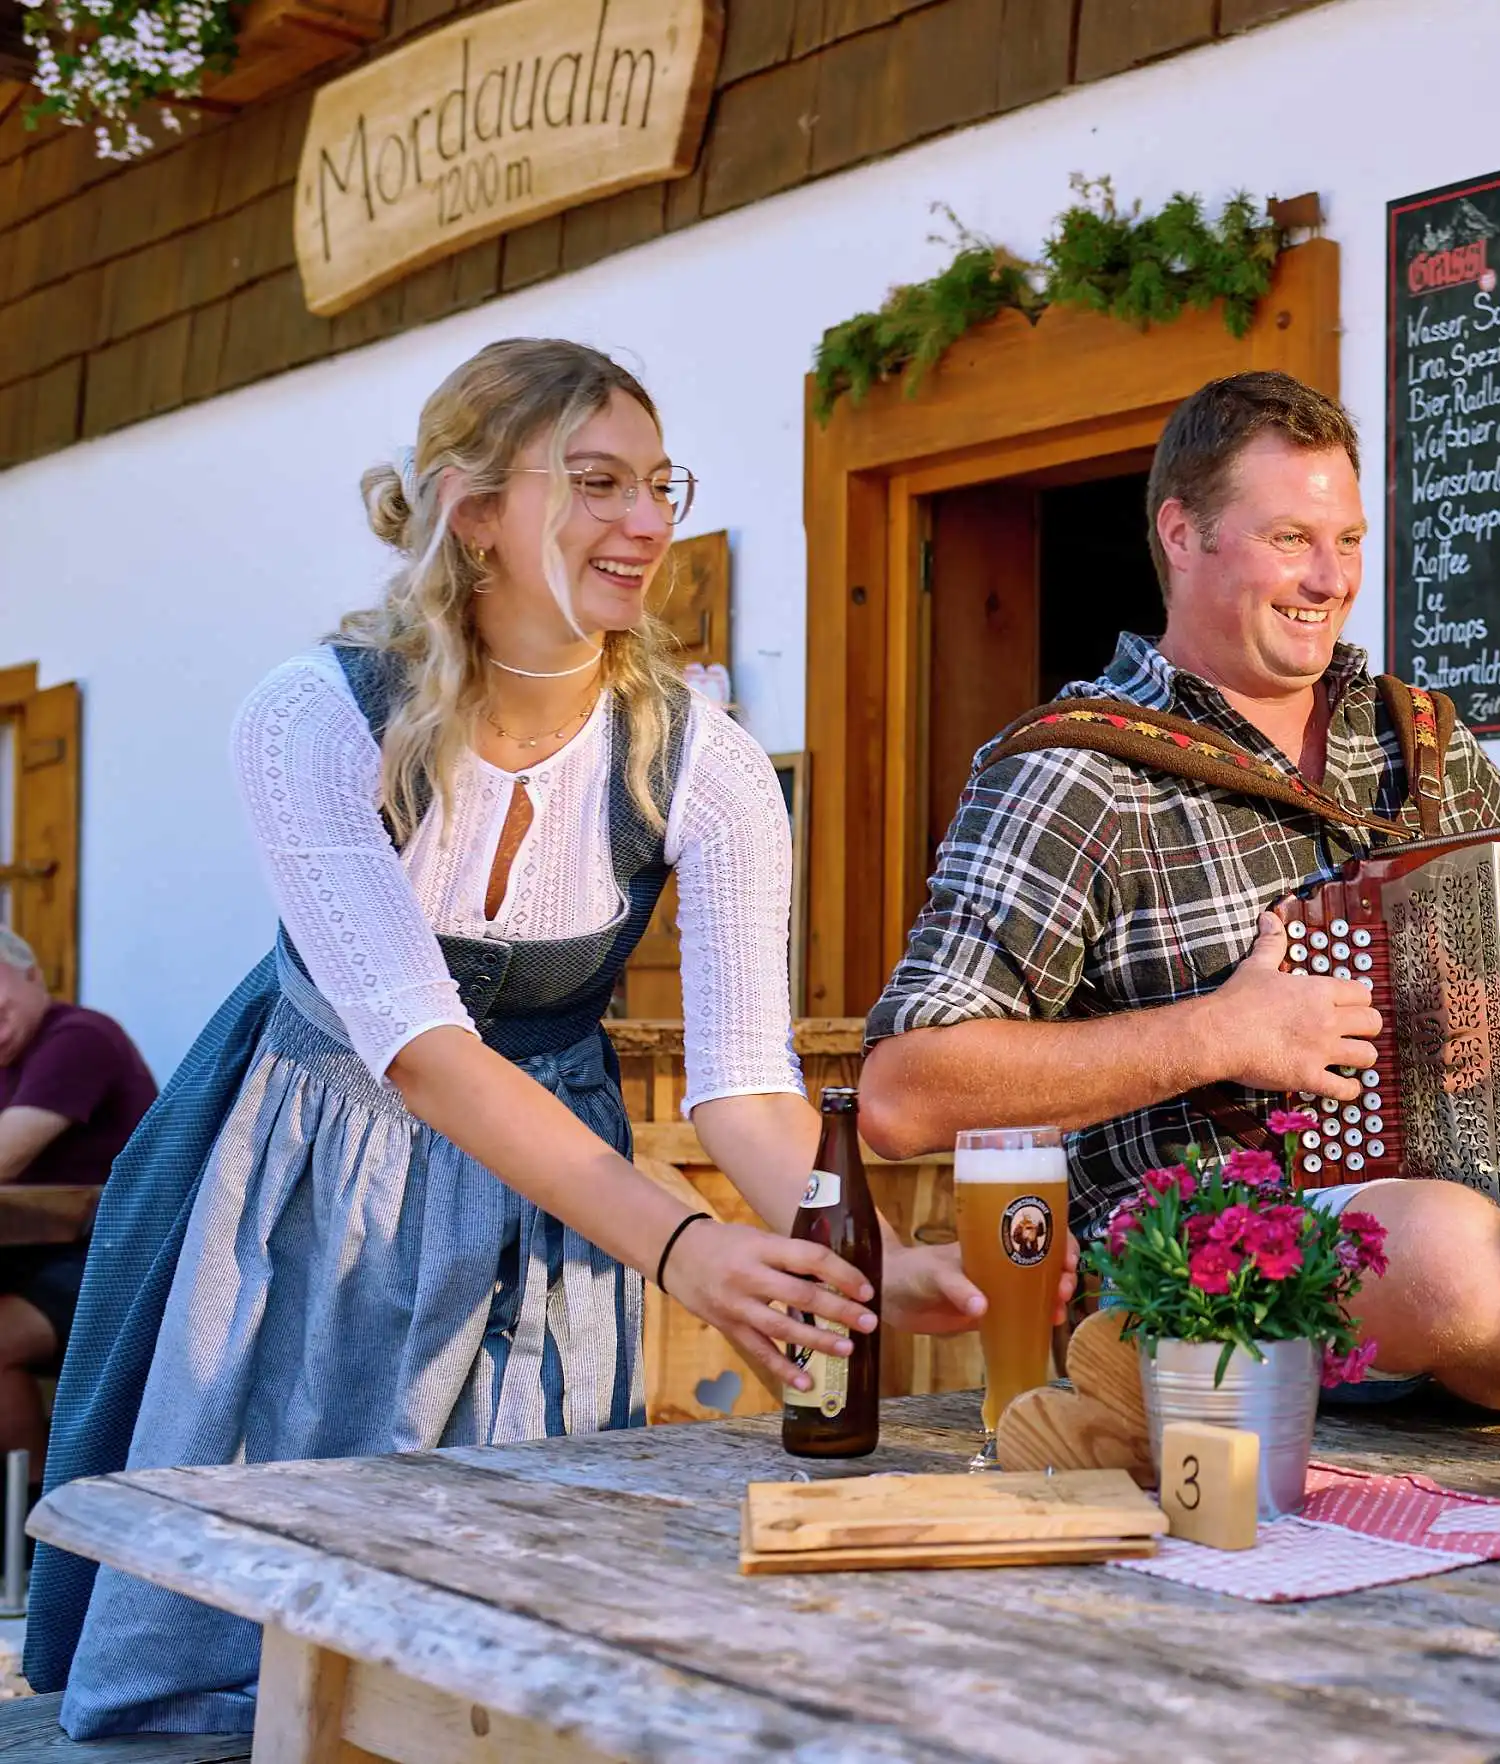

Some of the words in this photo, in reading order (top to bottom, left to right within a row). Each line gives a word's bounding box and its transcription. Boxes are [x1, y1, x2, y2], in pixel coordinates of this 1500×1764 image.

[317, 0, 654, 263] Mordaualm
[435, 153, 499, 228] 1200
[505, 156, 532, 202] m
[1411, 543, 1471, 582] Kaffee
[1414, 577, 1447, 613] Tee
[1411, 612, 1488, 649] Schnaps
[1175, 1454, 1201, 1511] 3
